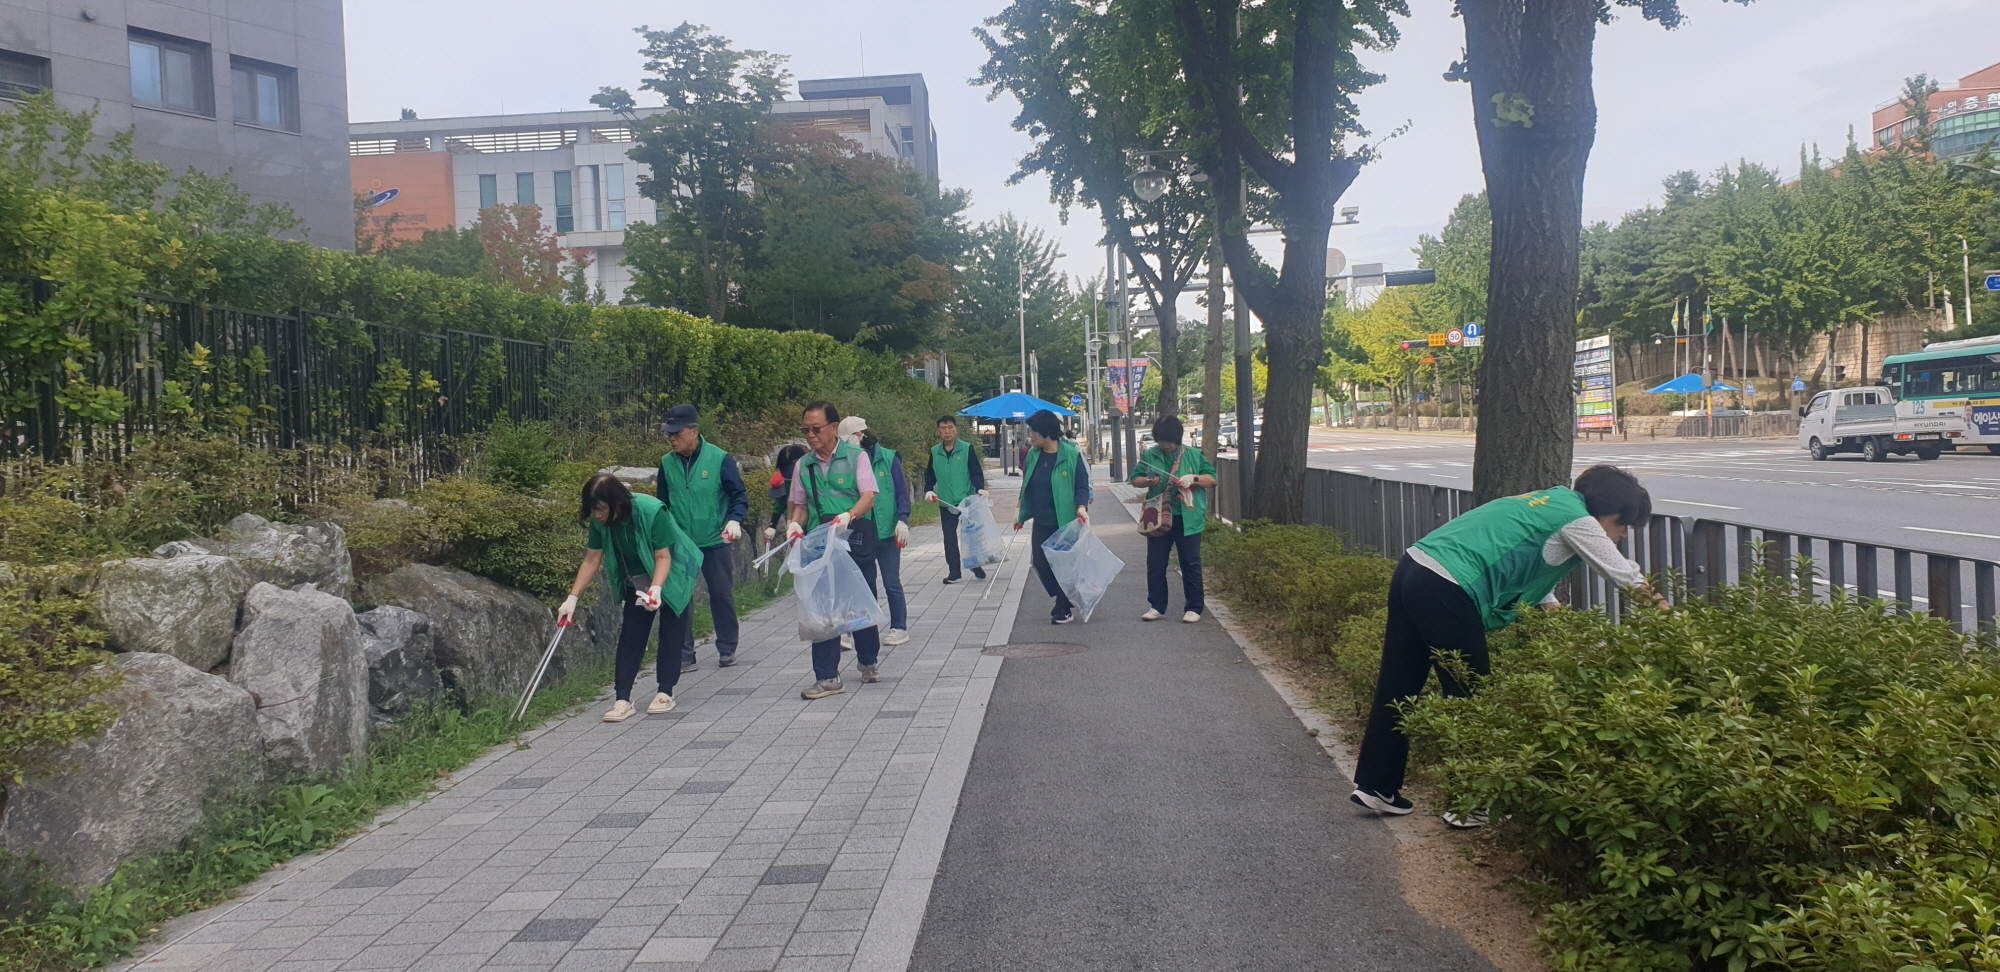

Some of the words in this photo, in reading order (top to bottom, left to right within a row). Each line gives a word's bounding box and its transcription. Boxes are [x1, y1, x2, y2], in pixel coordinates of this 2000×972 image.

[1450, 333, 1460, 341] 50
[1912, 401, 1925, 415] 125
[1973, 412, 2000, 425] 에이스
